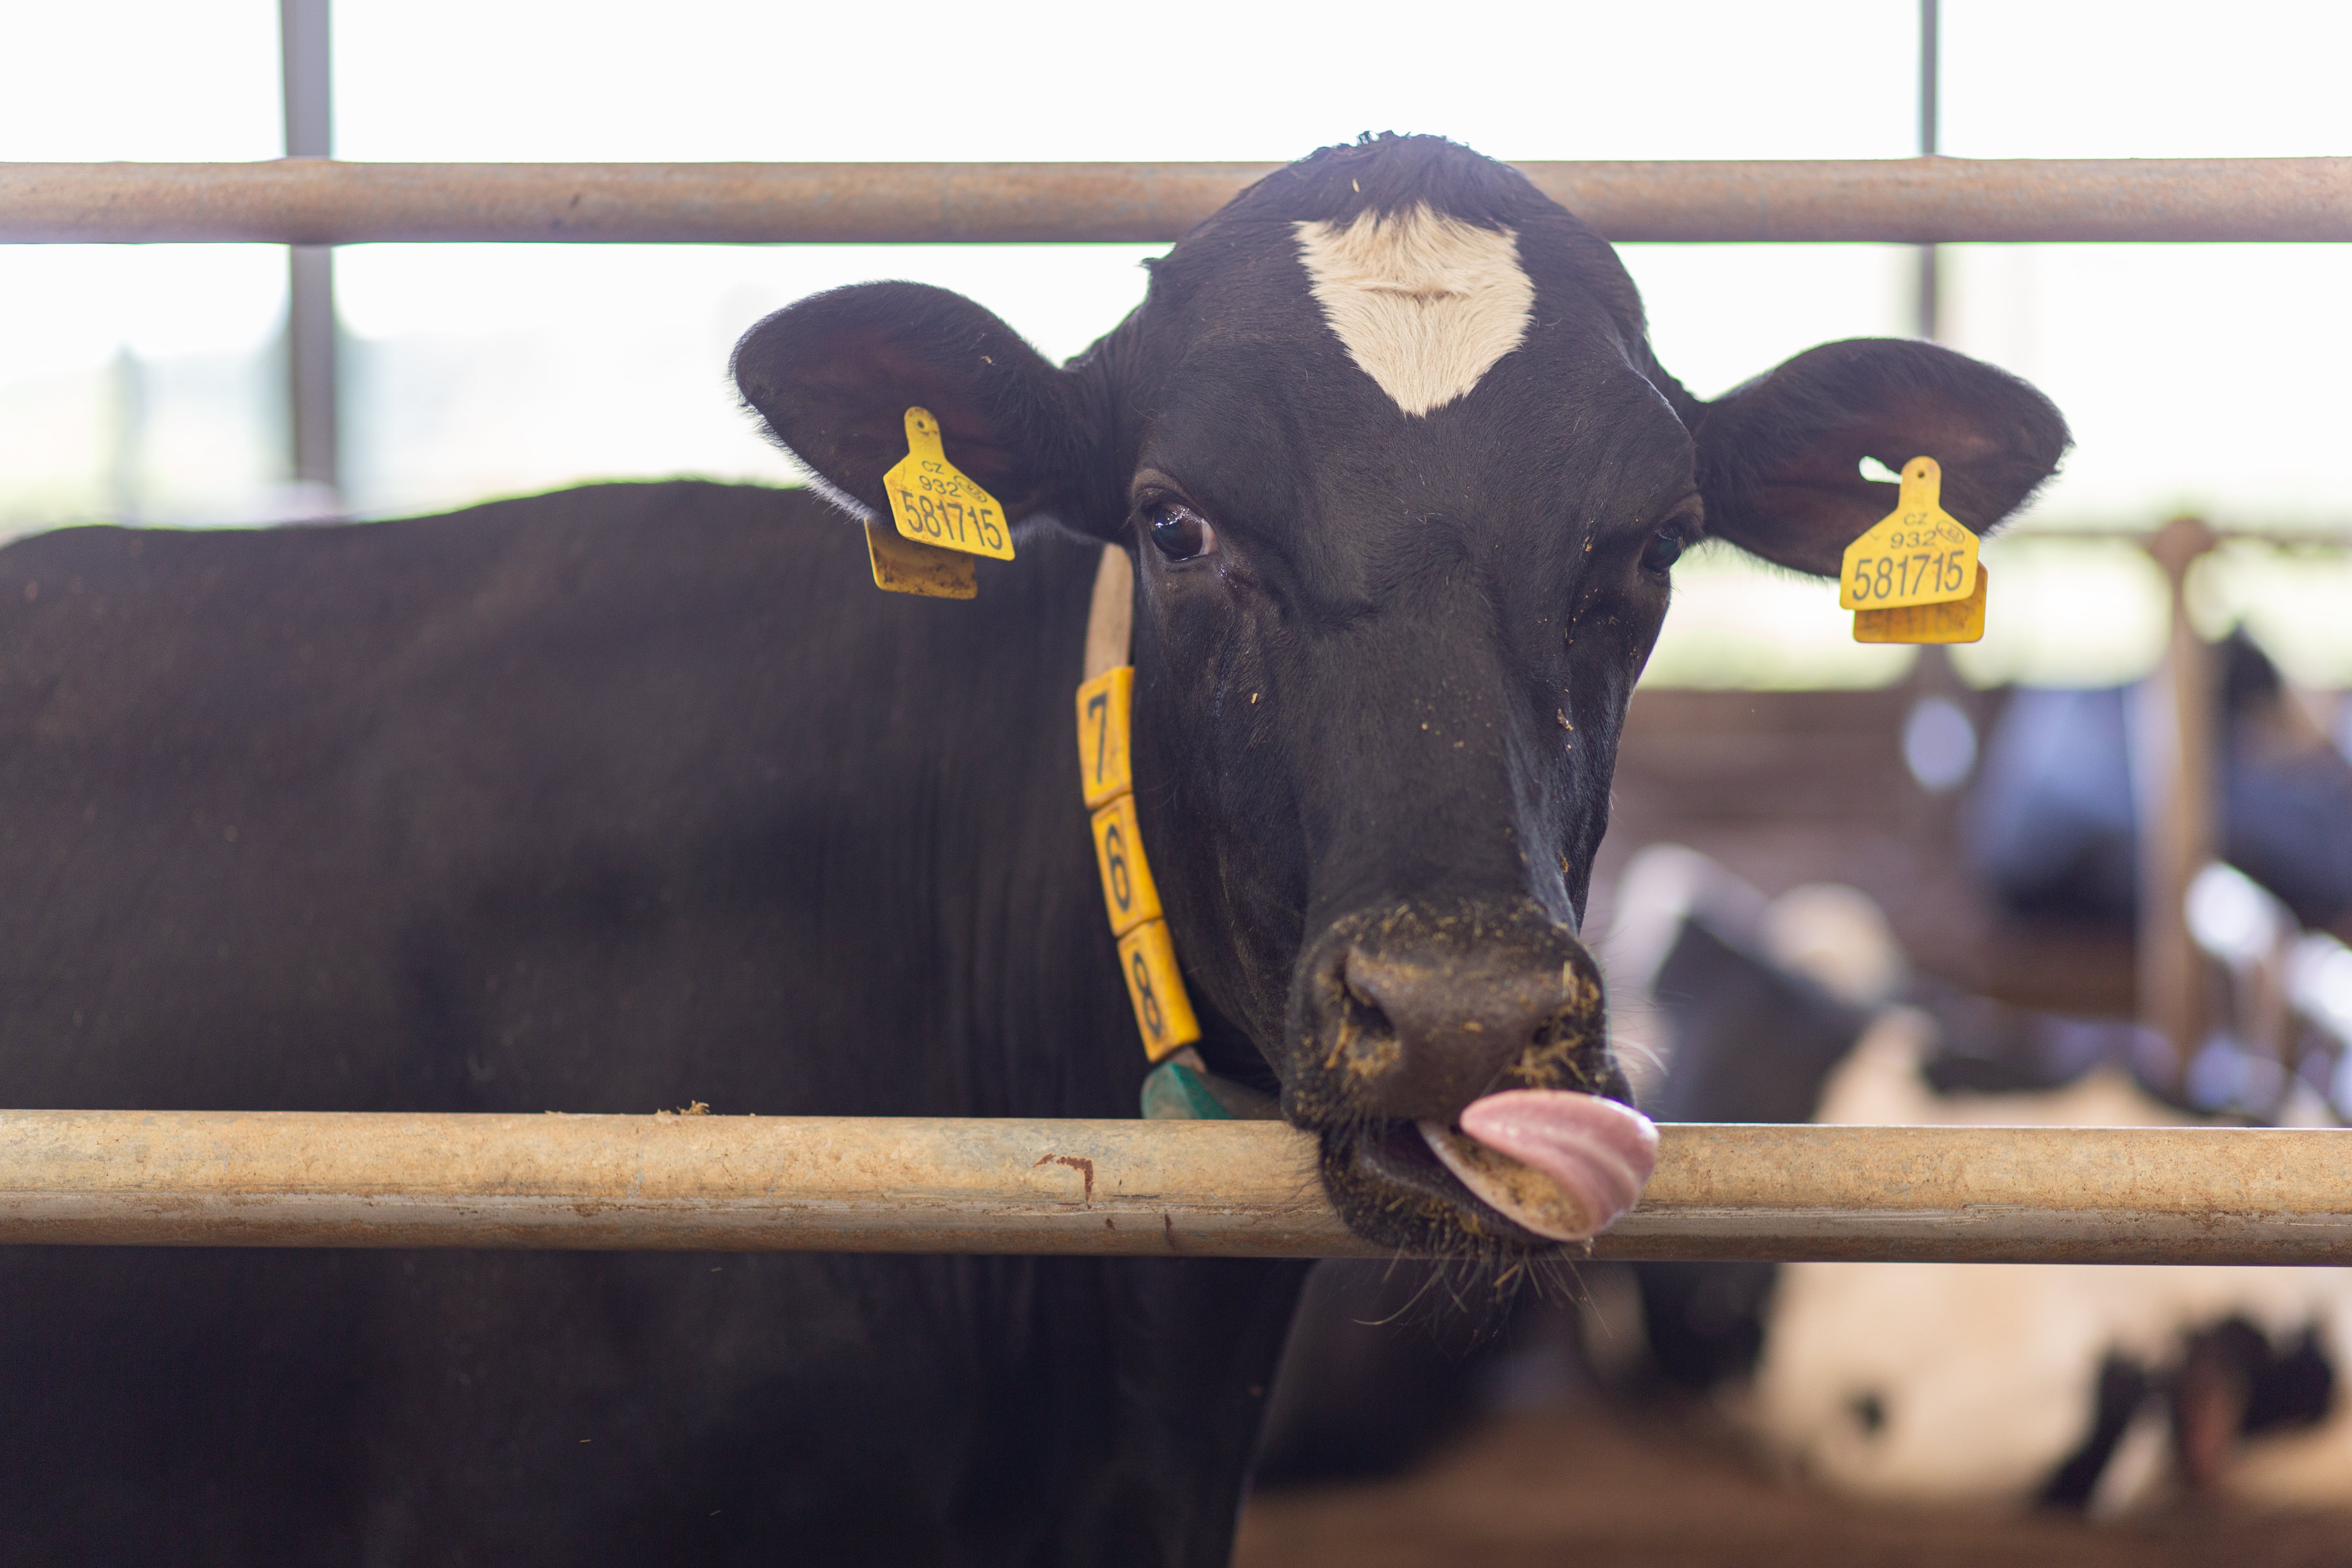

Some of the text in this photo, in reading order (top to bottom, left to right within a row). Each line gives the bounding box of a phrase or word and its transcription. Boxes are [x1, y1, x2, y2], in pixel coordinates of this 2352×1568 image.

[919, 475, 961, 497] 932
[922, 460, 945, 475] CZ
[902, 491, 1002, 550] 581715
[1890, 530, 1936, 549] 932
[1904, 513, 1928, 526] CZ
[1852, 550, 1964, 601] 581715
[1088, 692, 1108, 784] 7
[1106, 823, 1130, 912] 6
[1133, 951, 1161, 1037] 8
